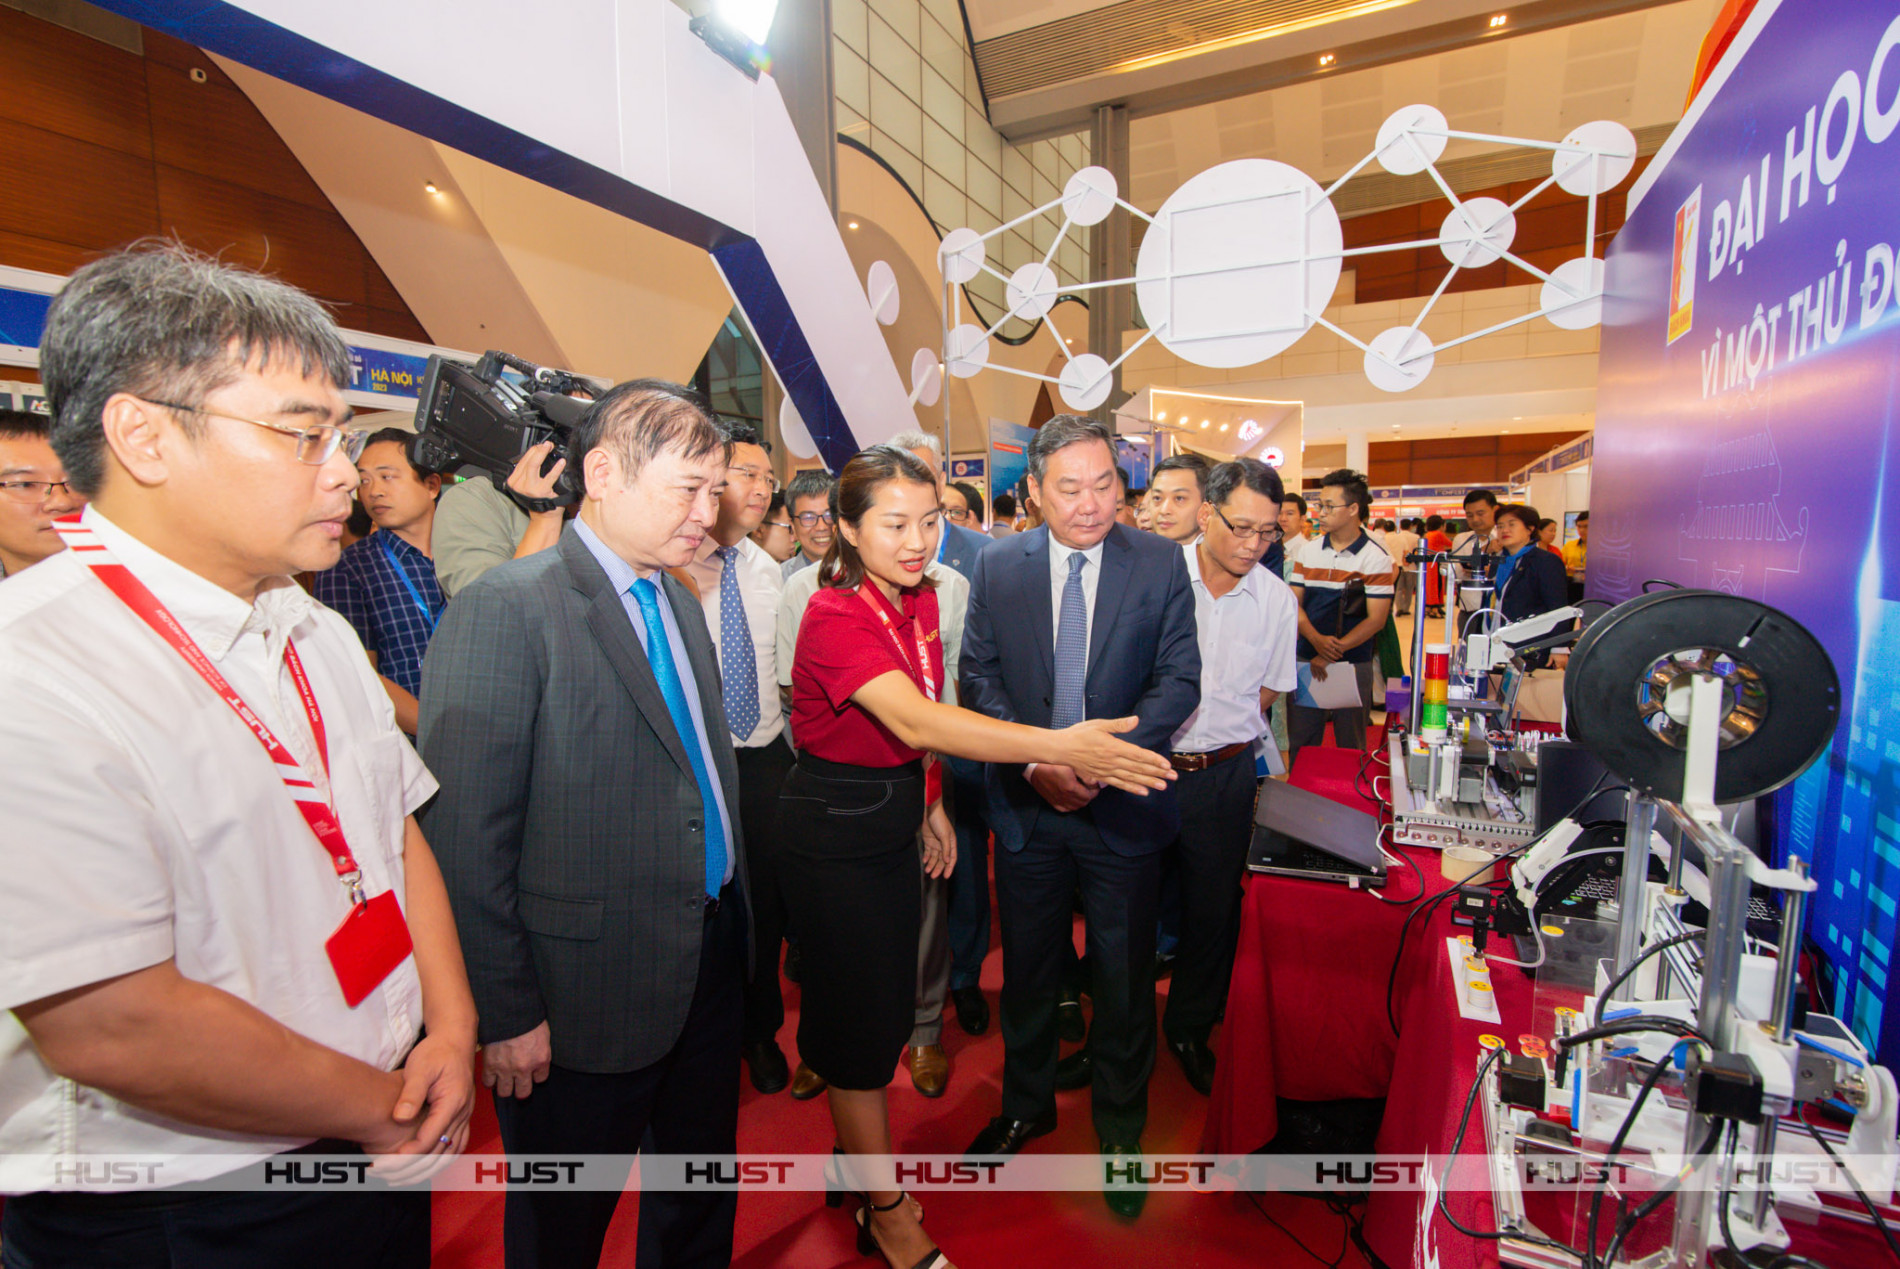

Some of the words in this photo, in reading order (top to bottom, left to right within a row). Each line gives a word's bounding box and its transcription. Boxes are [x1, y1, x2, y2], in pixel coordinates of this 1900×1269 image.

[1708, 152, 1770, 282] ĐẠI
[1701, 326, 1722, 400] VÌ
[1723, 302, 1783, 392] MỘT
[1787, 239, 1852, 363] THỦ
[1860, 241, 1900, 331] Đ
[371, 367, 390, 383] HÀ
[391, 370, 412, 387] NỘI
[372, 382, 387, 392] 2023
[917, 640, 929, 669] HUST
[297, 675, 309, 695] KHOA
[310, 708, 319, 722] NỘI
[226, 696, 279, 751] HUST
